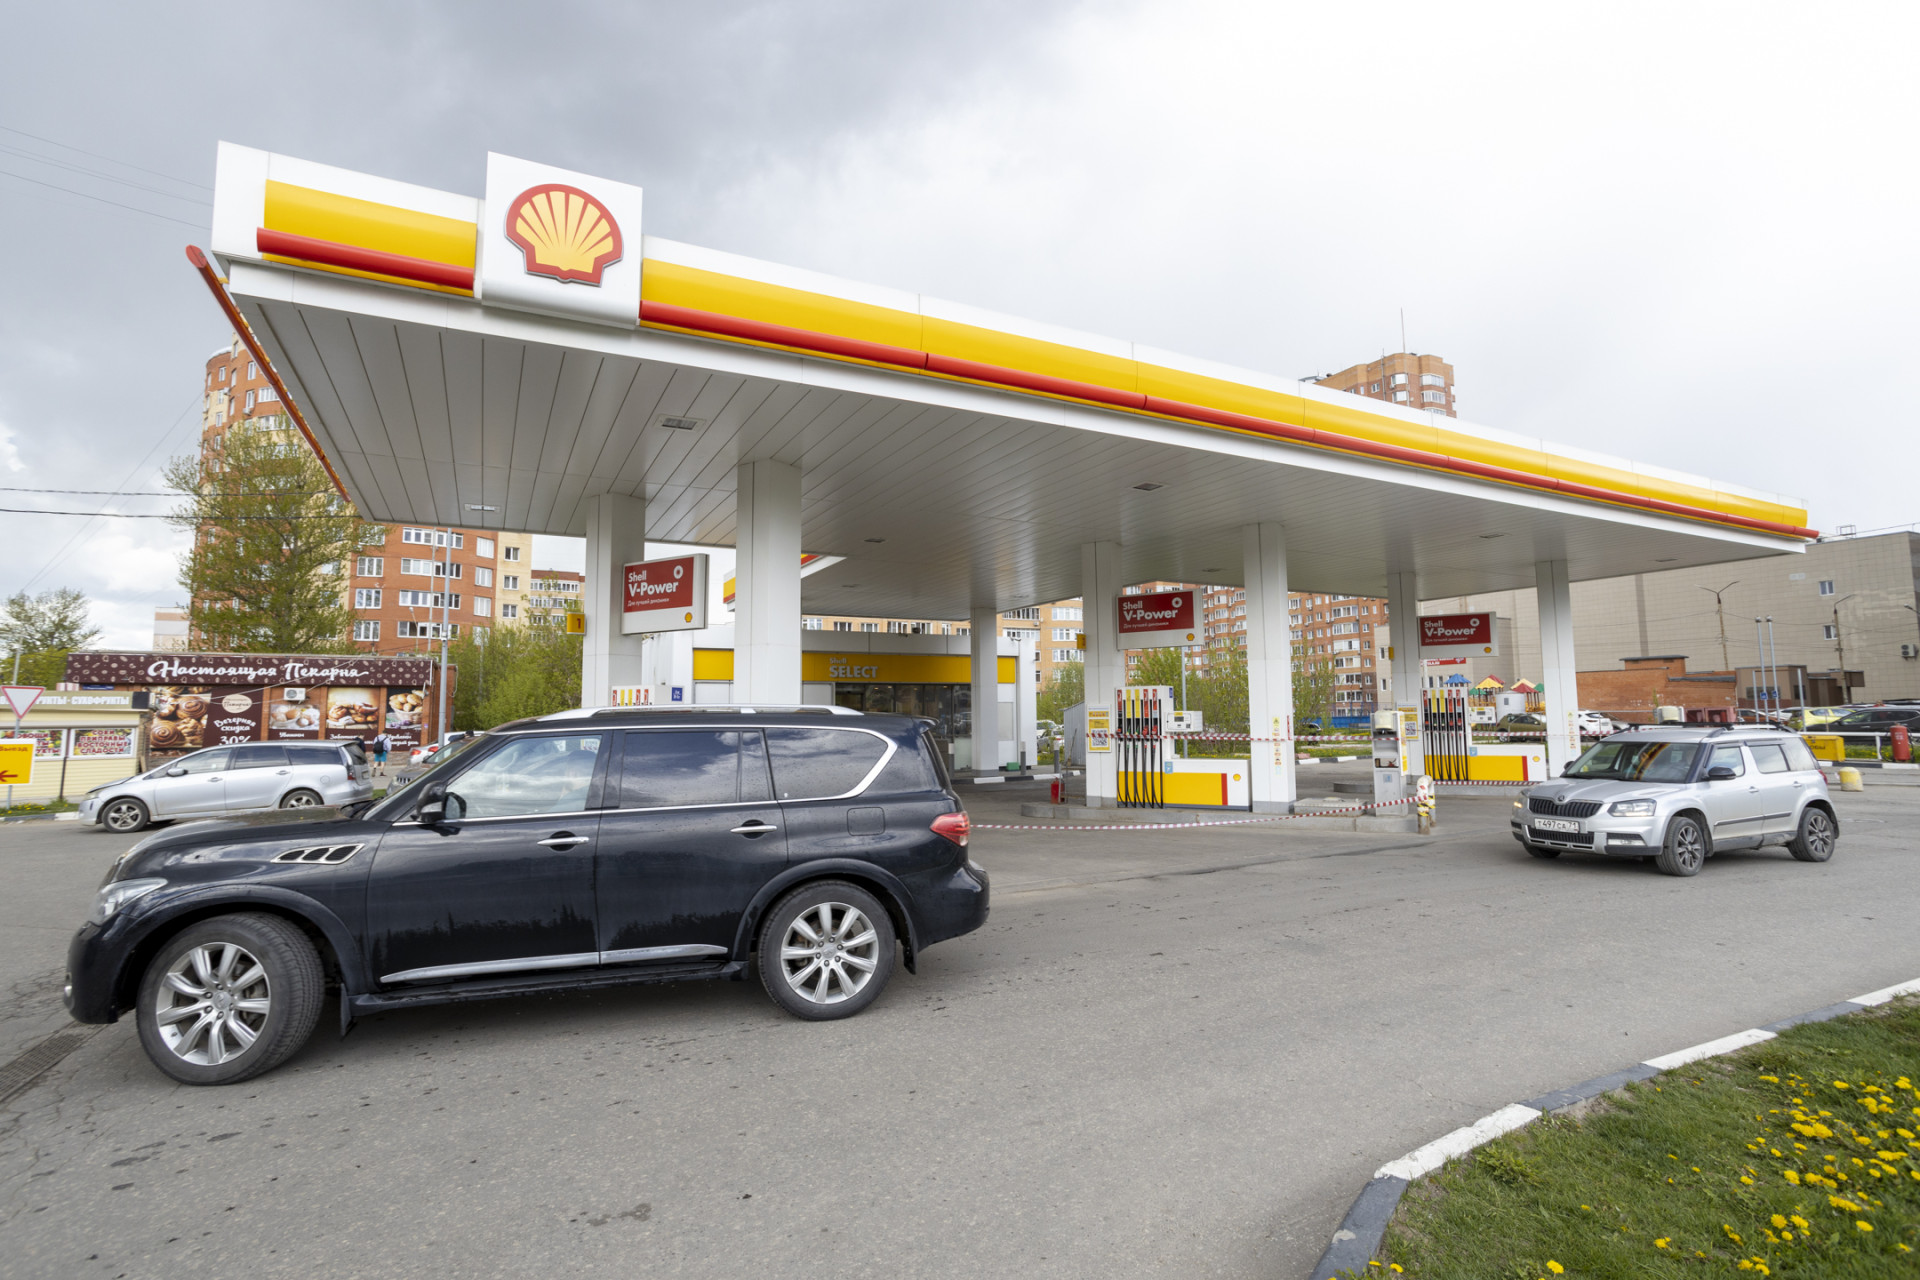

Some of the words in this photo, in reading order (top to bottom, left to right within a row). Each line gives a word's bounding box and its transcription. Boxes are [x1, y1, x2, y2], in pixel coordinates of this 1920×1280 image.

[628, 570, 647, 582] Shell
[628, 582, 679, 597] V-Power
[1122, 601, 1143, 610] Shell
[1123, 609, 1178, 621] V-Power
[1424, 620, 1443, 628] Shell
[1425, 627, 1476, 637] V-Power
[148, 660, 276, 680] Настоящая
[284, 662, 369, 681] Пекарня
[830, 665, 878, 678] SELECT
[71, 696, 130, 705] СУХОФРУКТЫ
[219, 736, 251, 745] 30%
